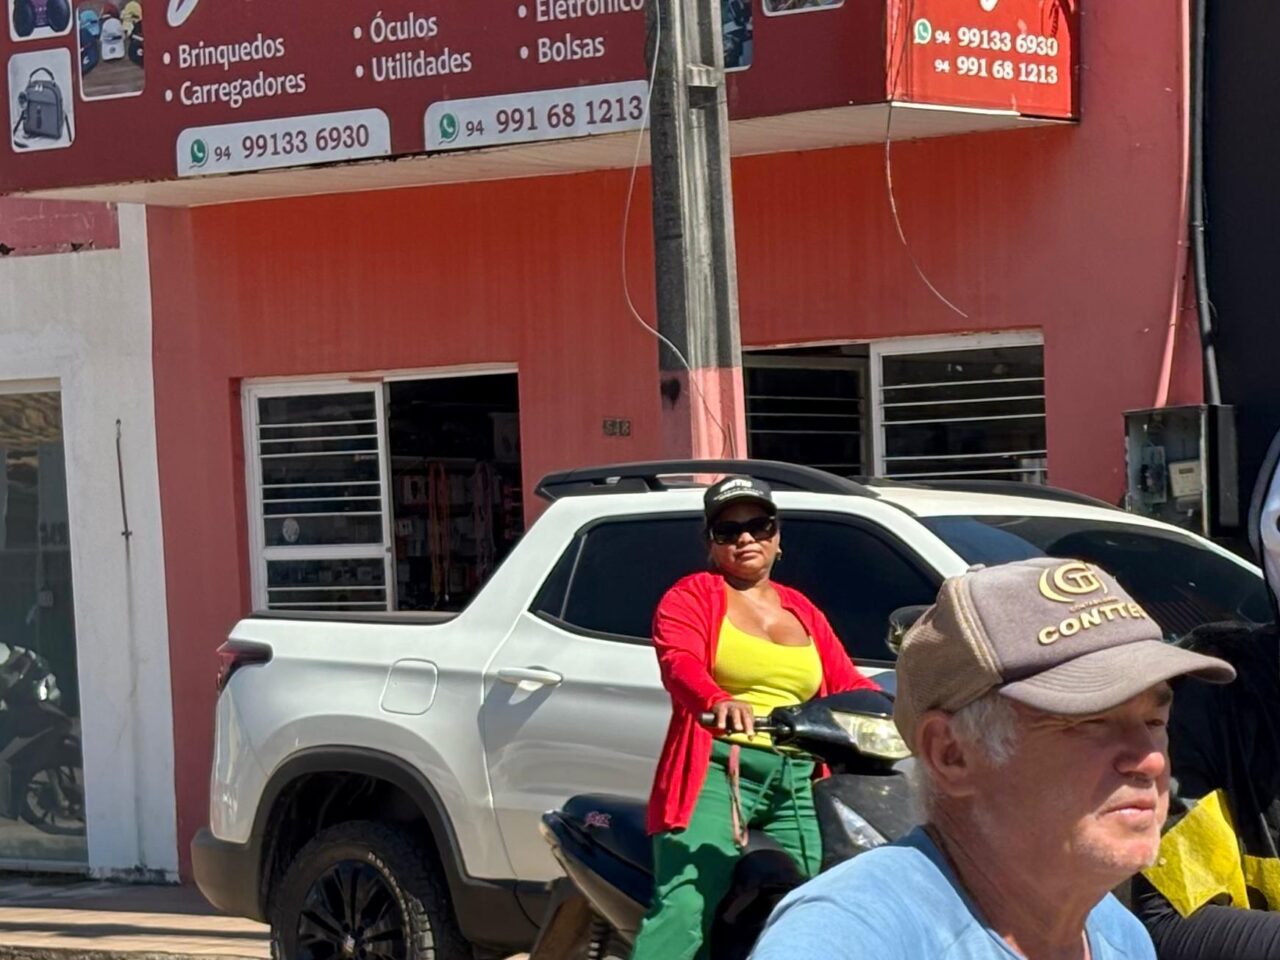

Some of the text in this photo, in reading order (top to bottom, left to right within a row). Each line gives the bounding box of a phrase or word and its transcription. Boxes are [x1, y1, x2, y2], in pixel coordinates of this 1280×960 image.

[370, 11, 438, 43] Óculos
[935, 26, 1058, 57] 94 99133 6930
[178, 33, 285, 70] Brinquedos
[371, 48, 473, 82] Utilidades
[537, 33, 605, 63] Bolsas
[934, 55, 1058, 84] 94 991 68 1213
[180, 71, 306, 108] Carregadores
[465, 95, 643, 137] 94 991 68 1213
[214, 124, 369, 162] 94 99133 6930
